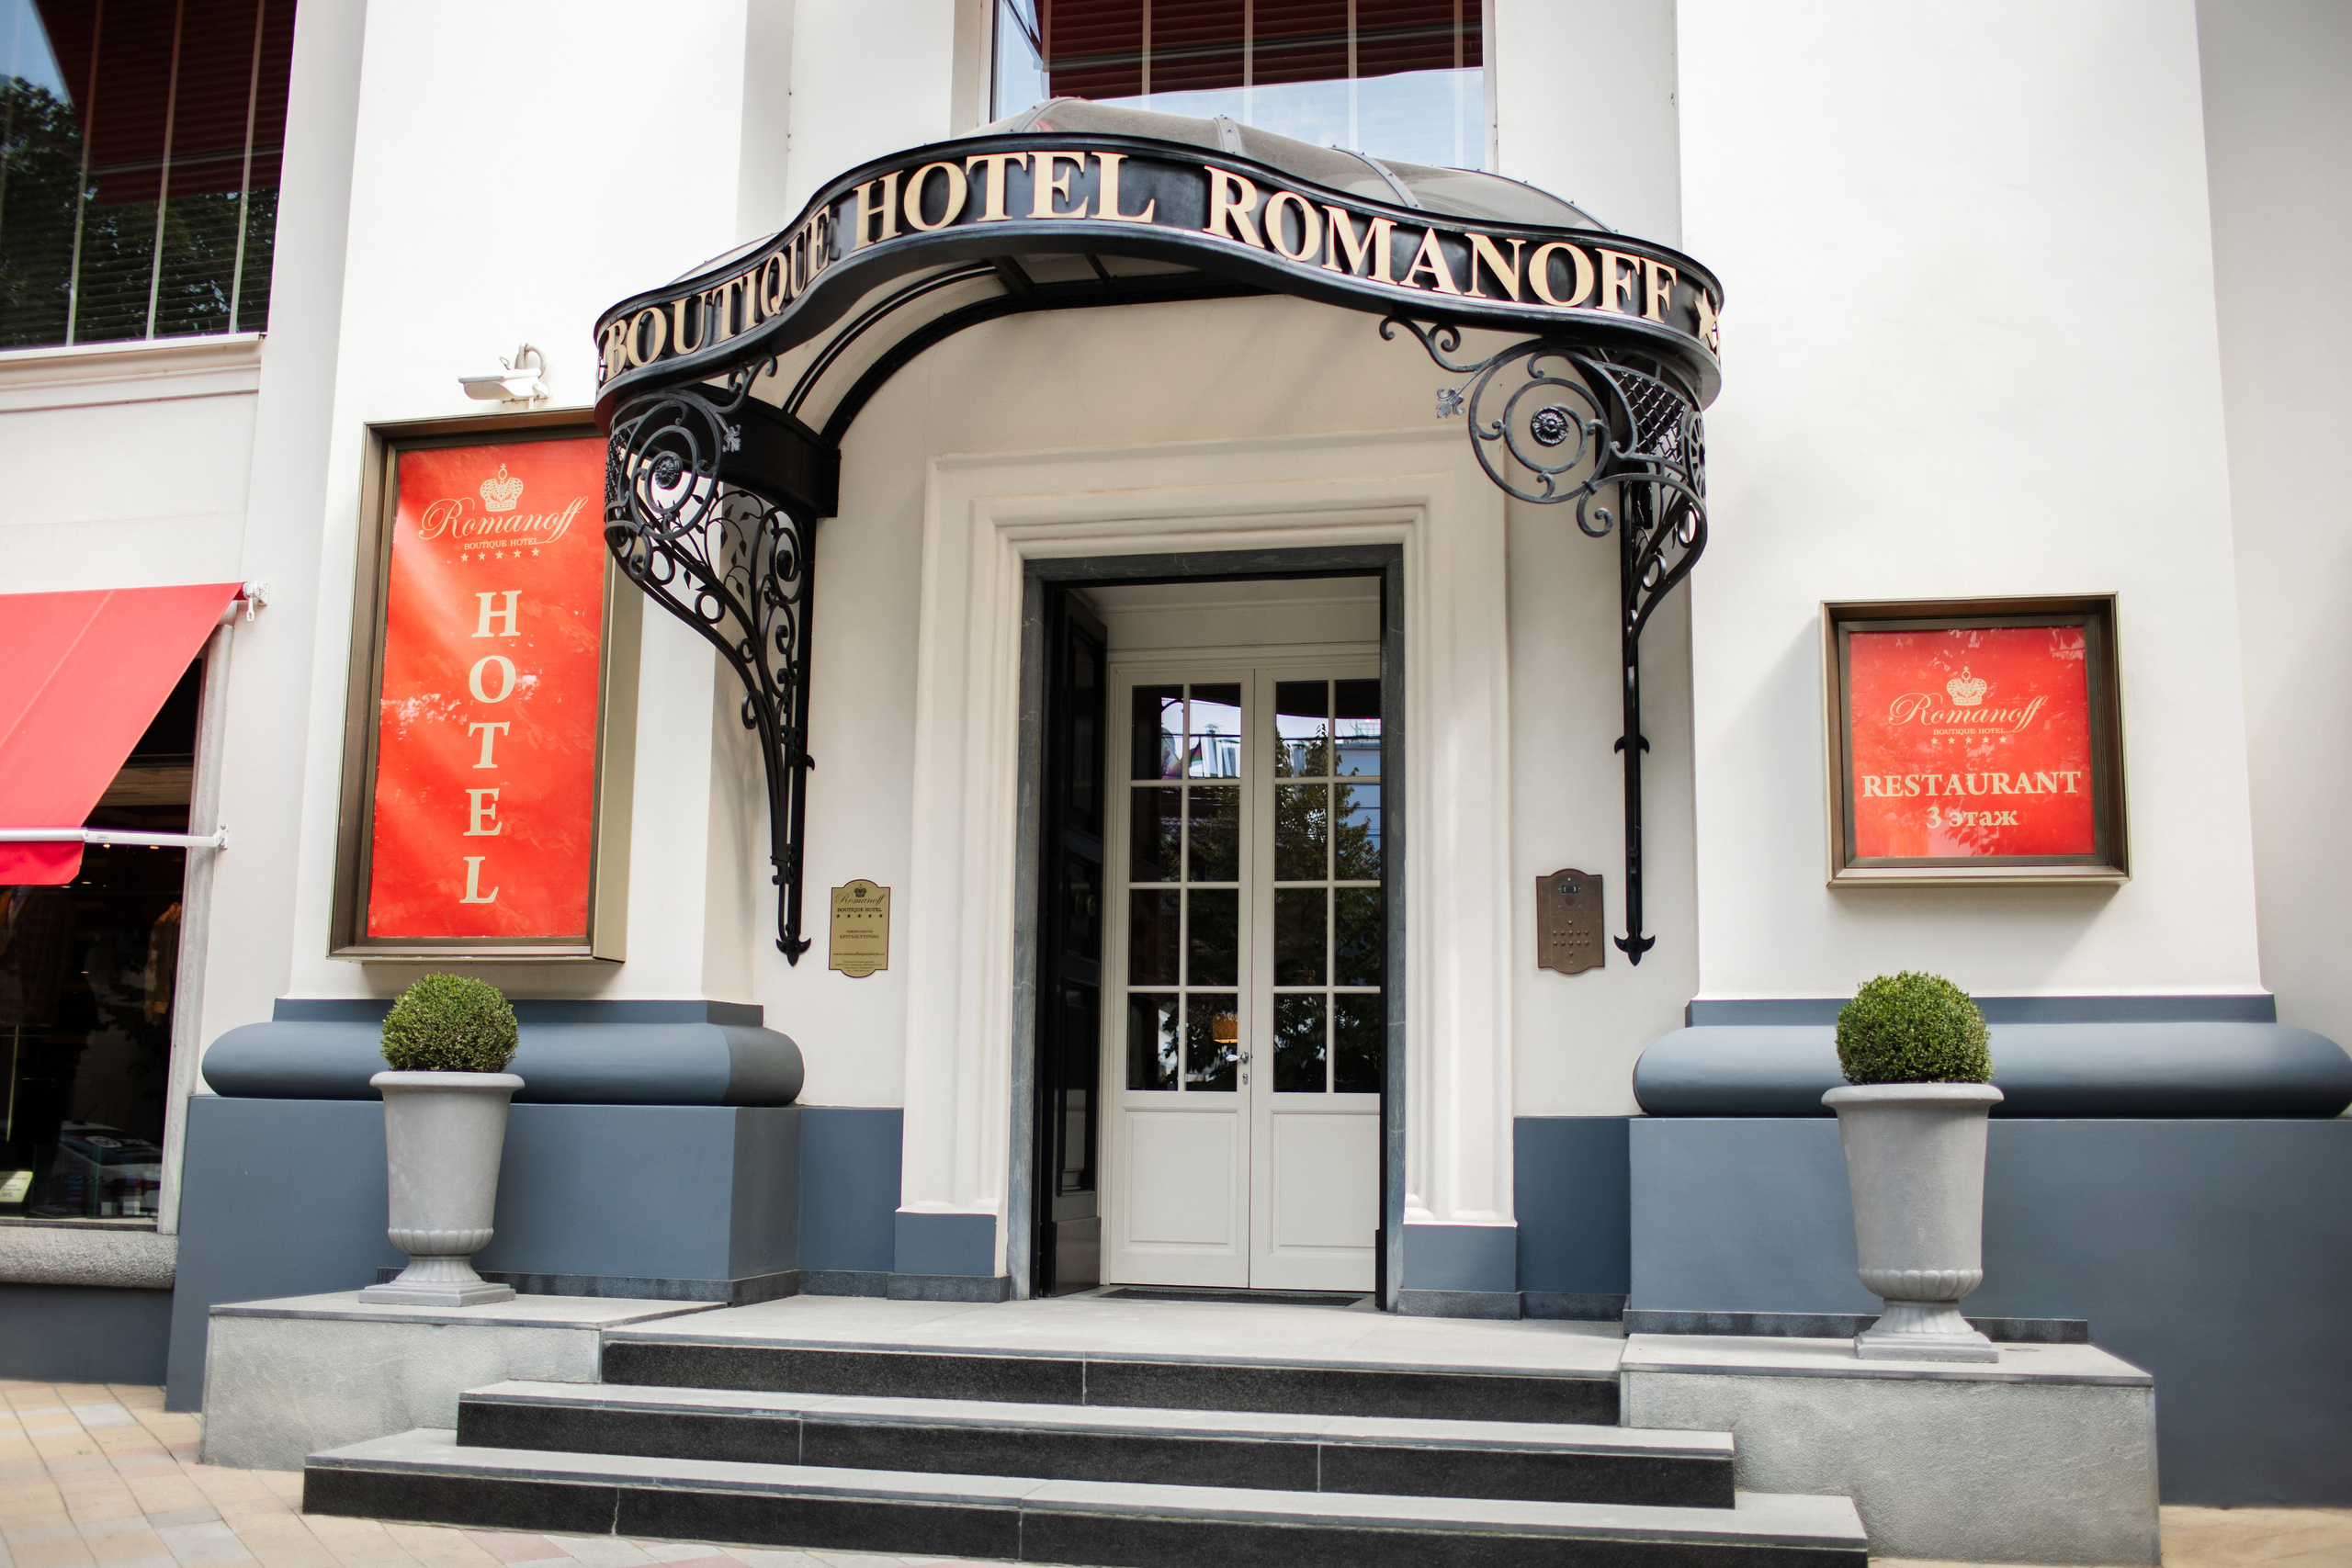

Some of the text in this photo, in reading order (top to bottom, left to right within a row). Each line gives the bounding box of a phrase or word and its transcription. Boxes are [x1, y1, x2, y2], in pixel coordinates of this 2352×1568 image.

[604, 151, 1677, 382] BOUTIQUE HOTEL ROMANOFF
[418, 496, 589, 544] Romanoff
[464, 537, 539, 550] BOUTIQUE HOTEL
[1888, 693, 2049, 733] Romanoff
[459, 590, 523, 904] HOTEL
[1862, 771, 2082, 797] RESTAURANT
[1926, 807, 2018, 829] 3 этаж
[835, 892, 886, 907] Romanoff
